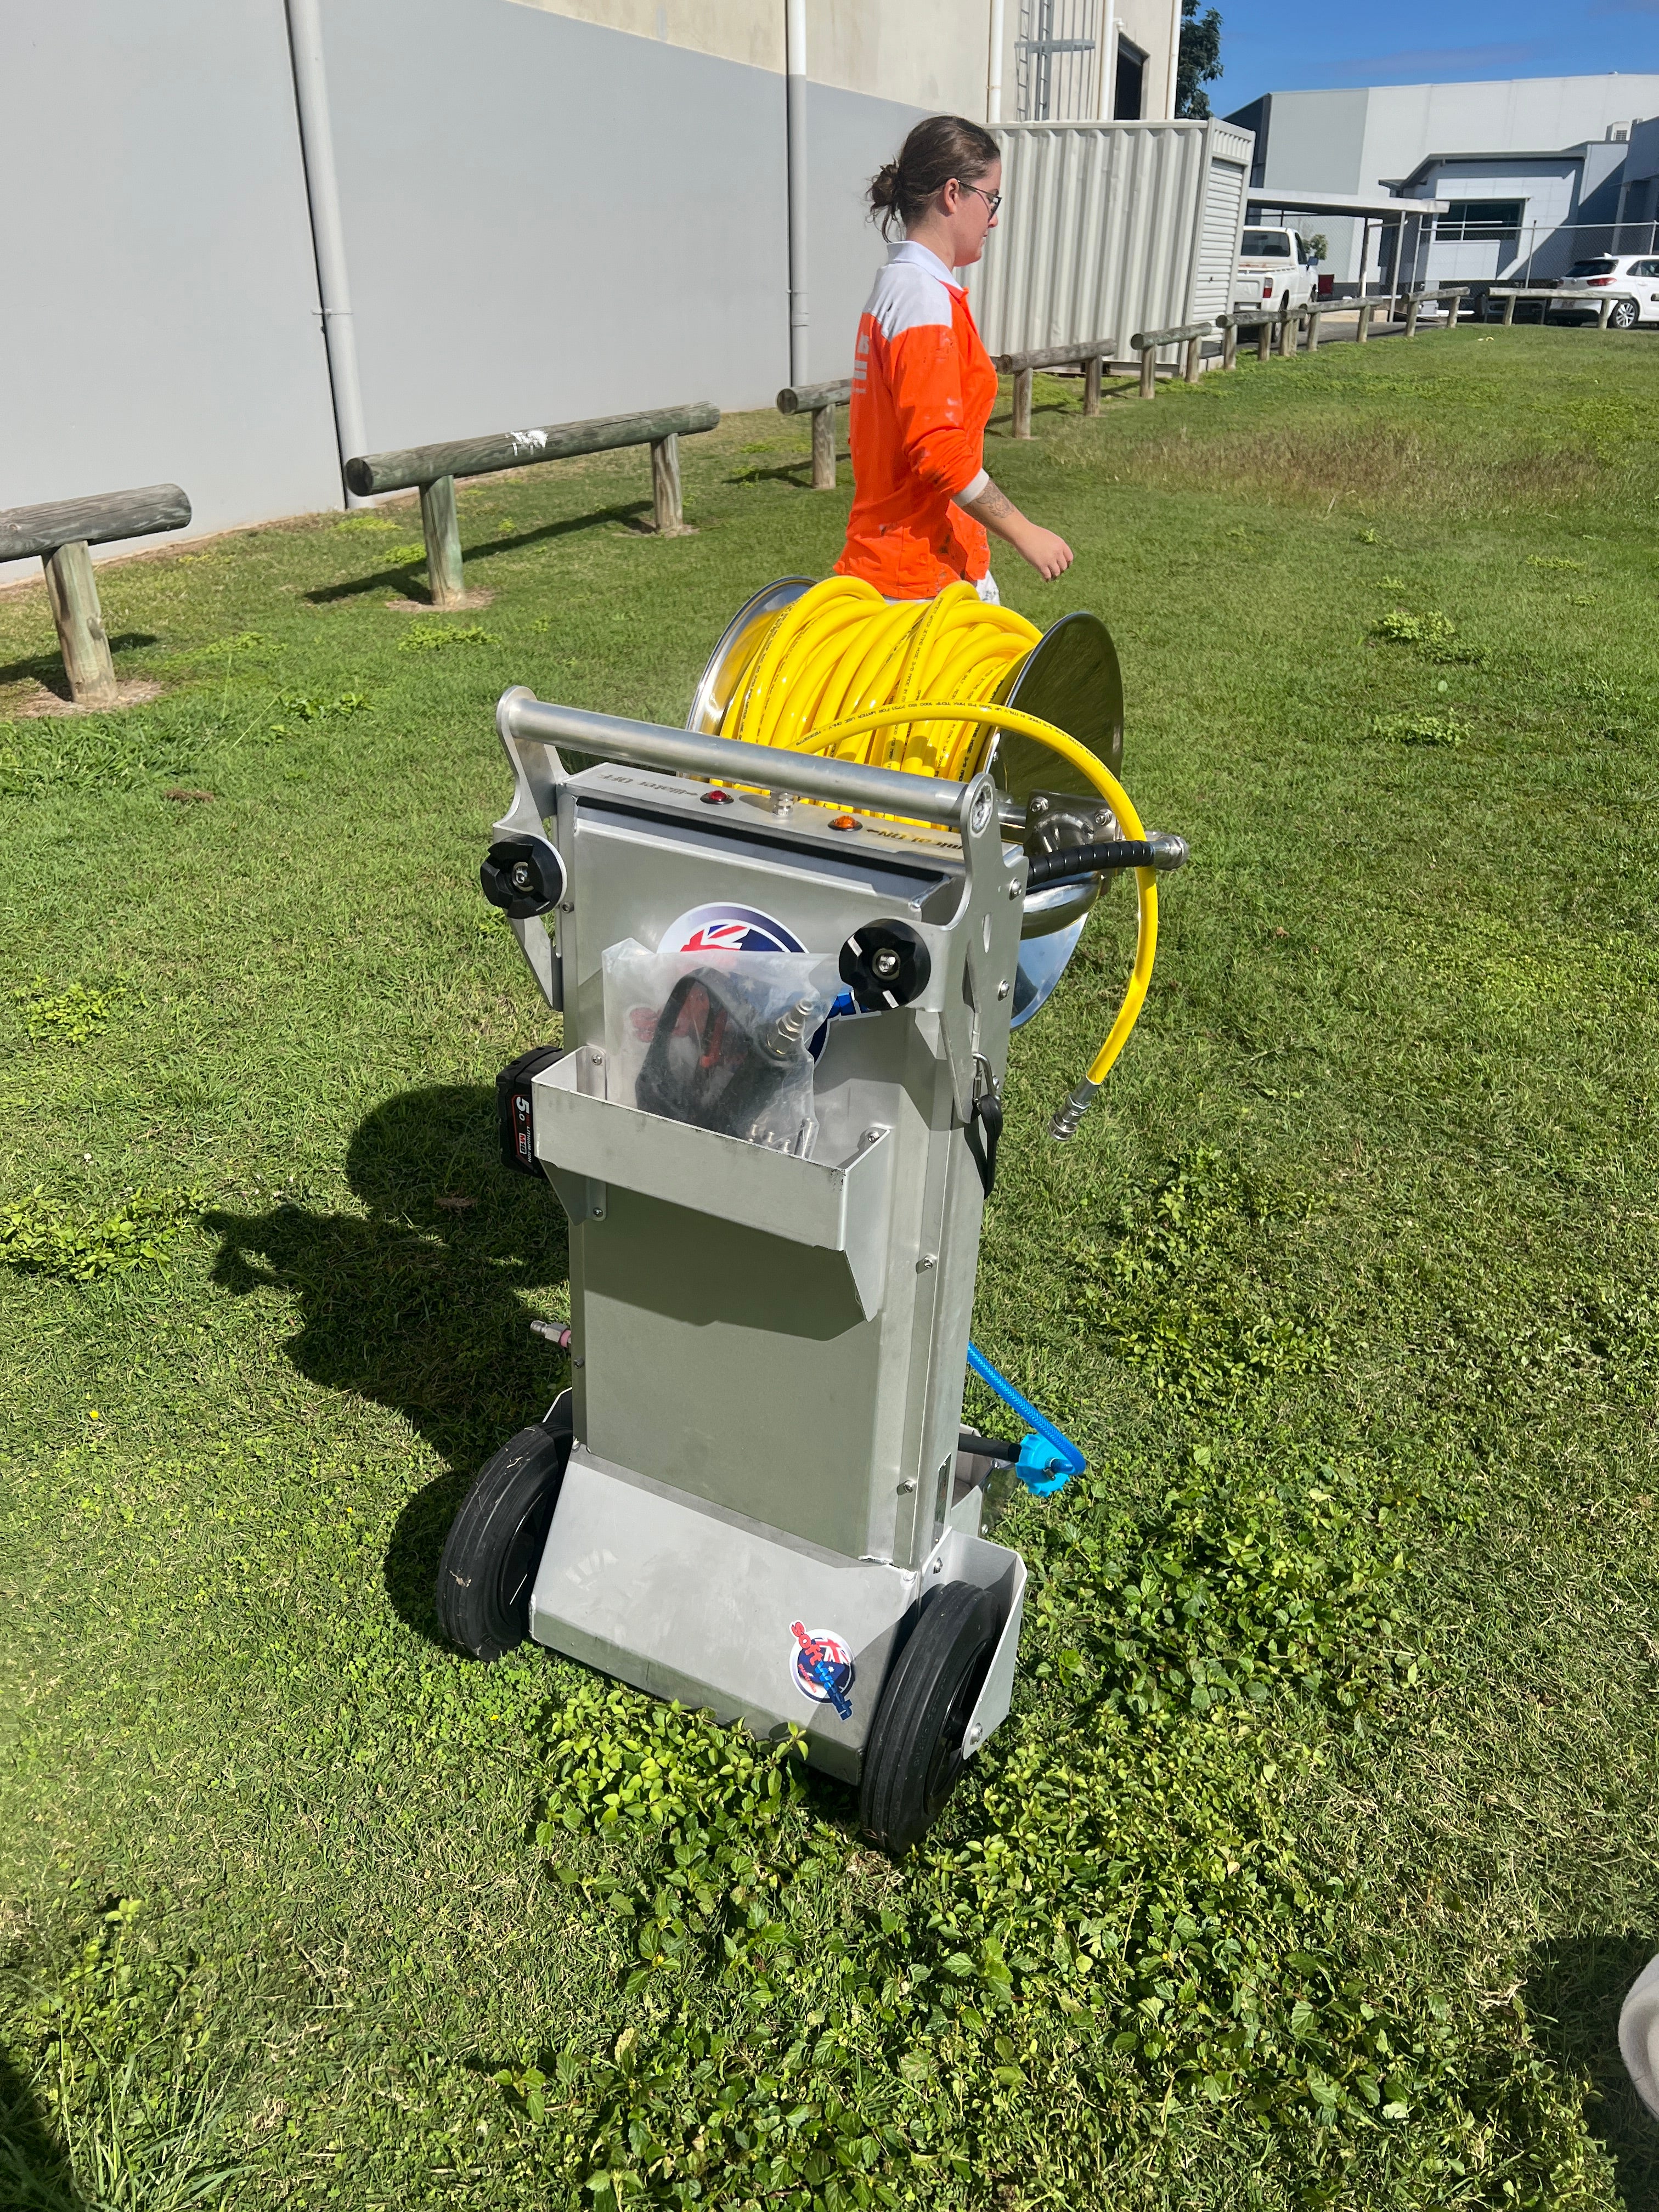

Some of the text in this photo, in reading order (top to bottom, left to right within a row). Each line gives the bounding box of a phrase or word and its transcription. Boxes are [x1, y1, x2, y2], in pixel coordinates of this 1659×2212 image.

[919, 629, 928, 646] JETTING
[1004, 708, 1019, 716] ITALY
[828, 721, 842, 730] ONLY
